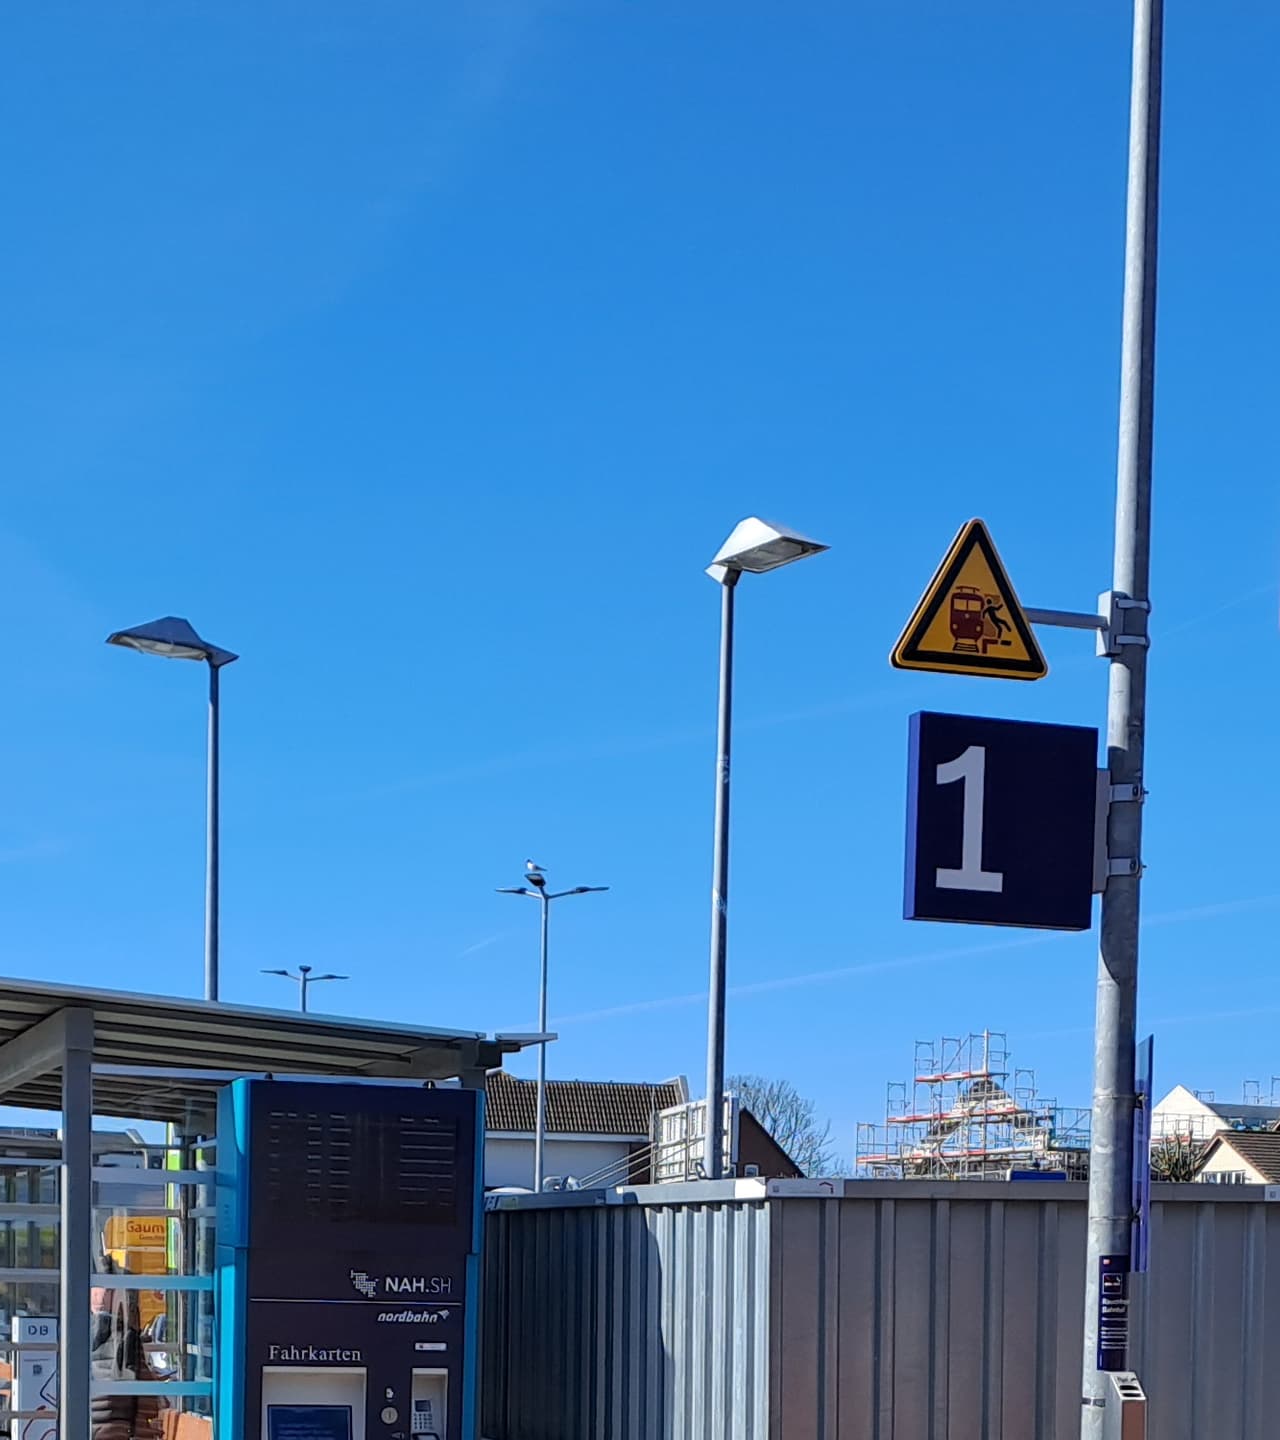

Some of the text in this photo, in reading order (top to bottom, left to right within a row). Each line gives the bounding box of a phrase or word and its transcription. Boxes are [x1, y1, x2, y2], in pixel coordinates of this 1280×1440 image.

[935, 745, 1004, 893] 1
[384, 1277, 452, 1294] NAH.SH
[377, 1311, 439, 1324] nordbahn
[28, 1325, 49, 1336] DB
[269, 1345, 362, 1361] Fahrkarten
